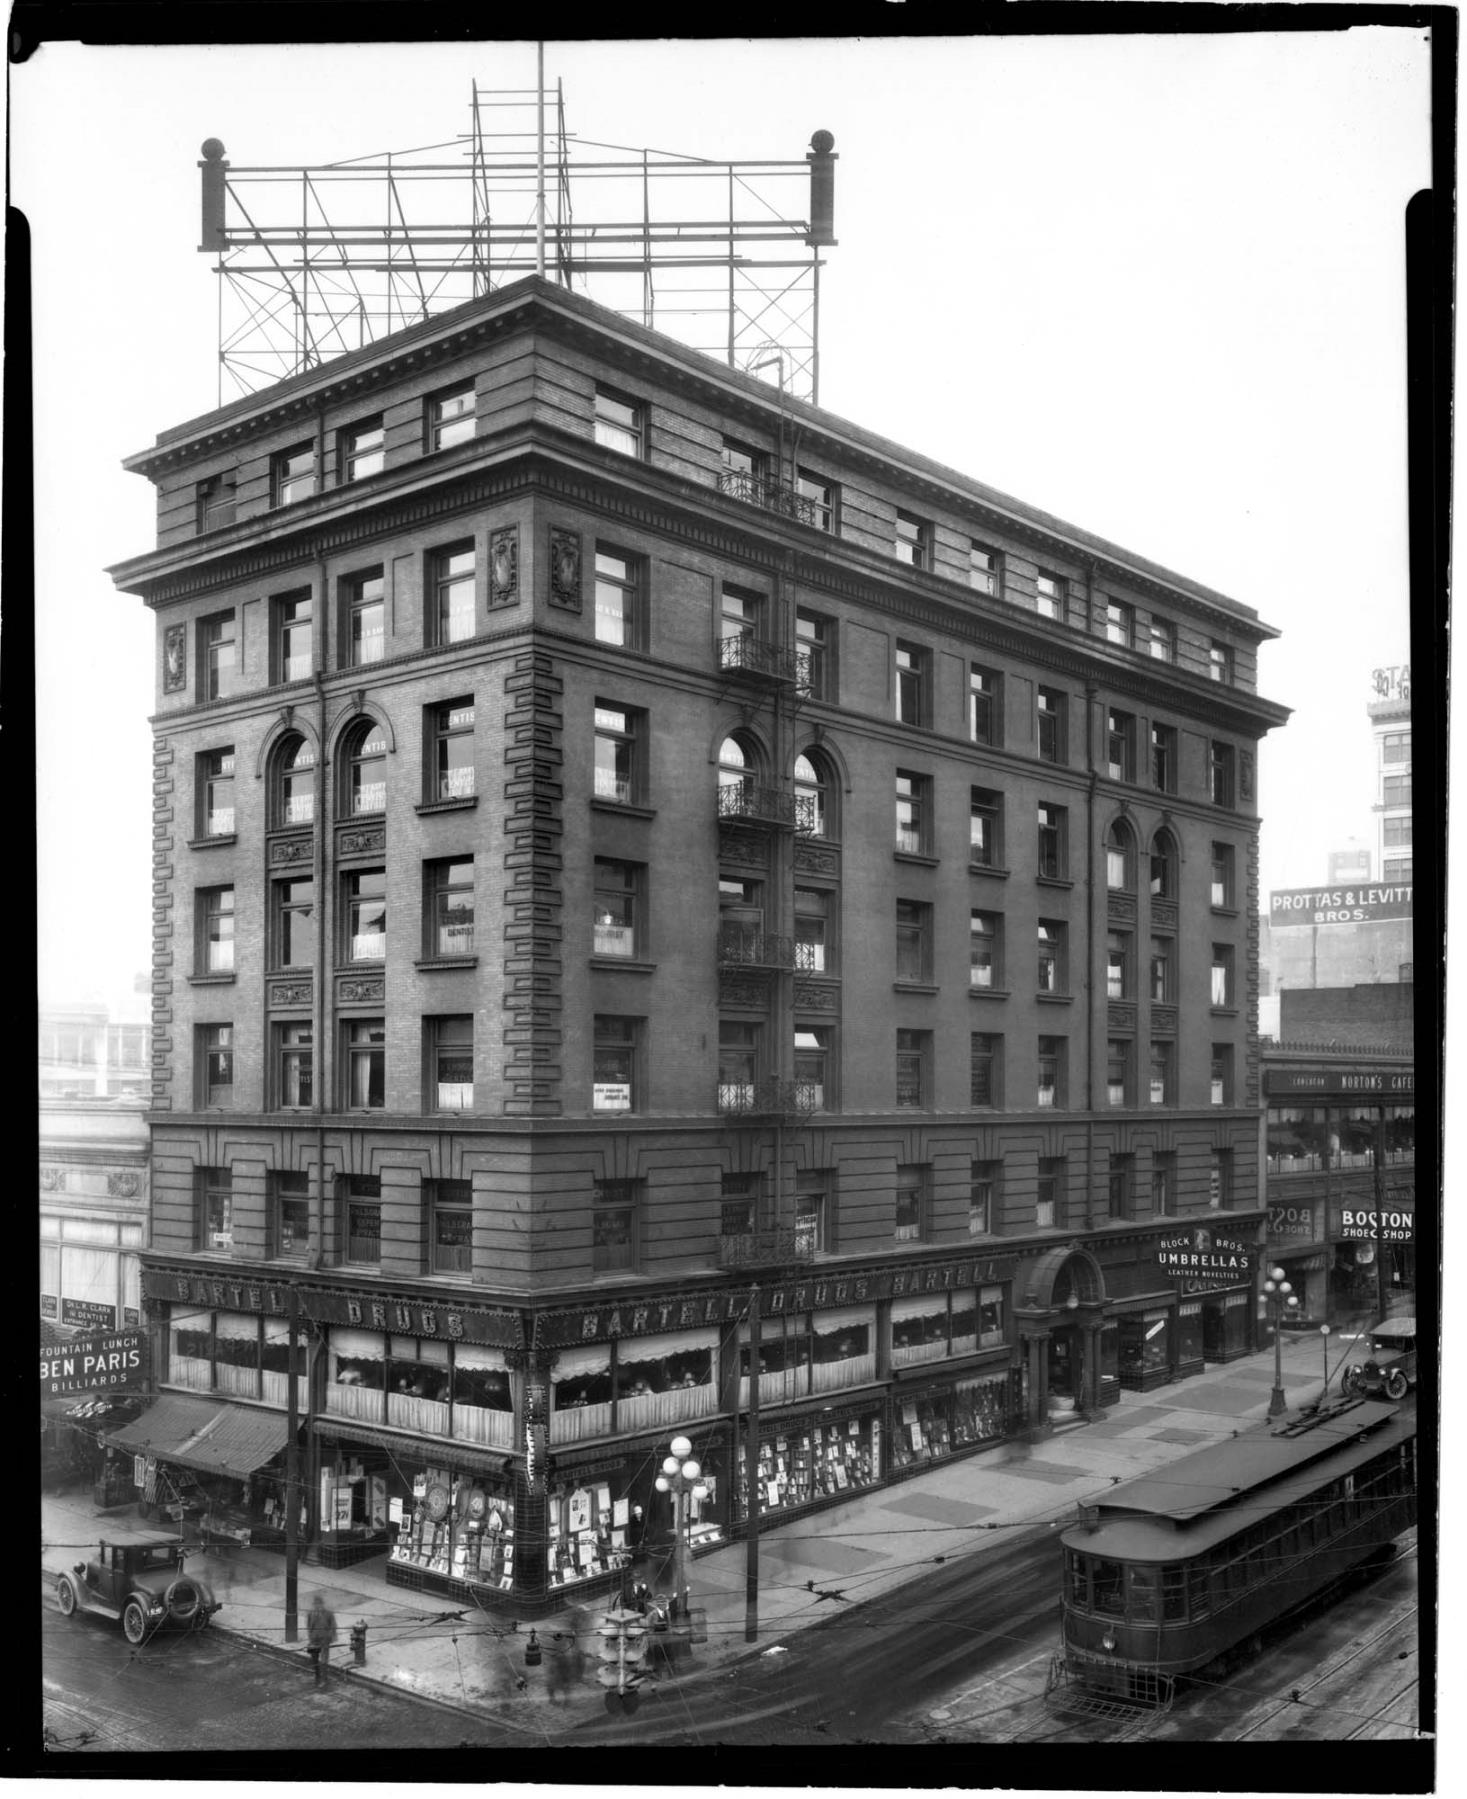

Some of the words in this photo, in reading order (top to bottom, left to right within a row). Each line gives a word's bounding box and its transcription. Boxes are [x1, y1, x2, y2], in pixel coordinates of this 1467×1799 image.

[1272, 891, 1342, 911] PROTTAS
[1345, 891, 1355, 906] &
[1314, 909, 1369, 923] BROS.
[1341, 1074, 1383, 1089] NORTON'S
[1160, 1236, 1190, 1249] BLOCK
[1216, 1238, 1246, 1253] BROS.
[1382, 1229, 1412, 1240] SHOP
[1158, 1252, 1249, 1269] UMBRELLAS
[893, 1262, 997, 1295] BARTELL
[1168, 1269, 1199, 1277] LEATHER
[1201, 1270, 1240, 1280] NOVELTIES
[177, 1279, 304, 1315] BARTEL
[347, 1299, 464, 1338] DRUGS
[582, 1296, 740, 1339] BARTELL
[771, 1279, 869, 1312] DRUGS
[40, 1342, 93, 1357] FOUNTAIN
[102, 1337, 138, 1351] LUNCH
[40, 1358, 75, 1379] BEN
[83, 1350, 140, 1375] PARIS
[51, 1373, 128, 1393] BILLIARDS
